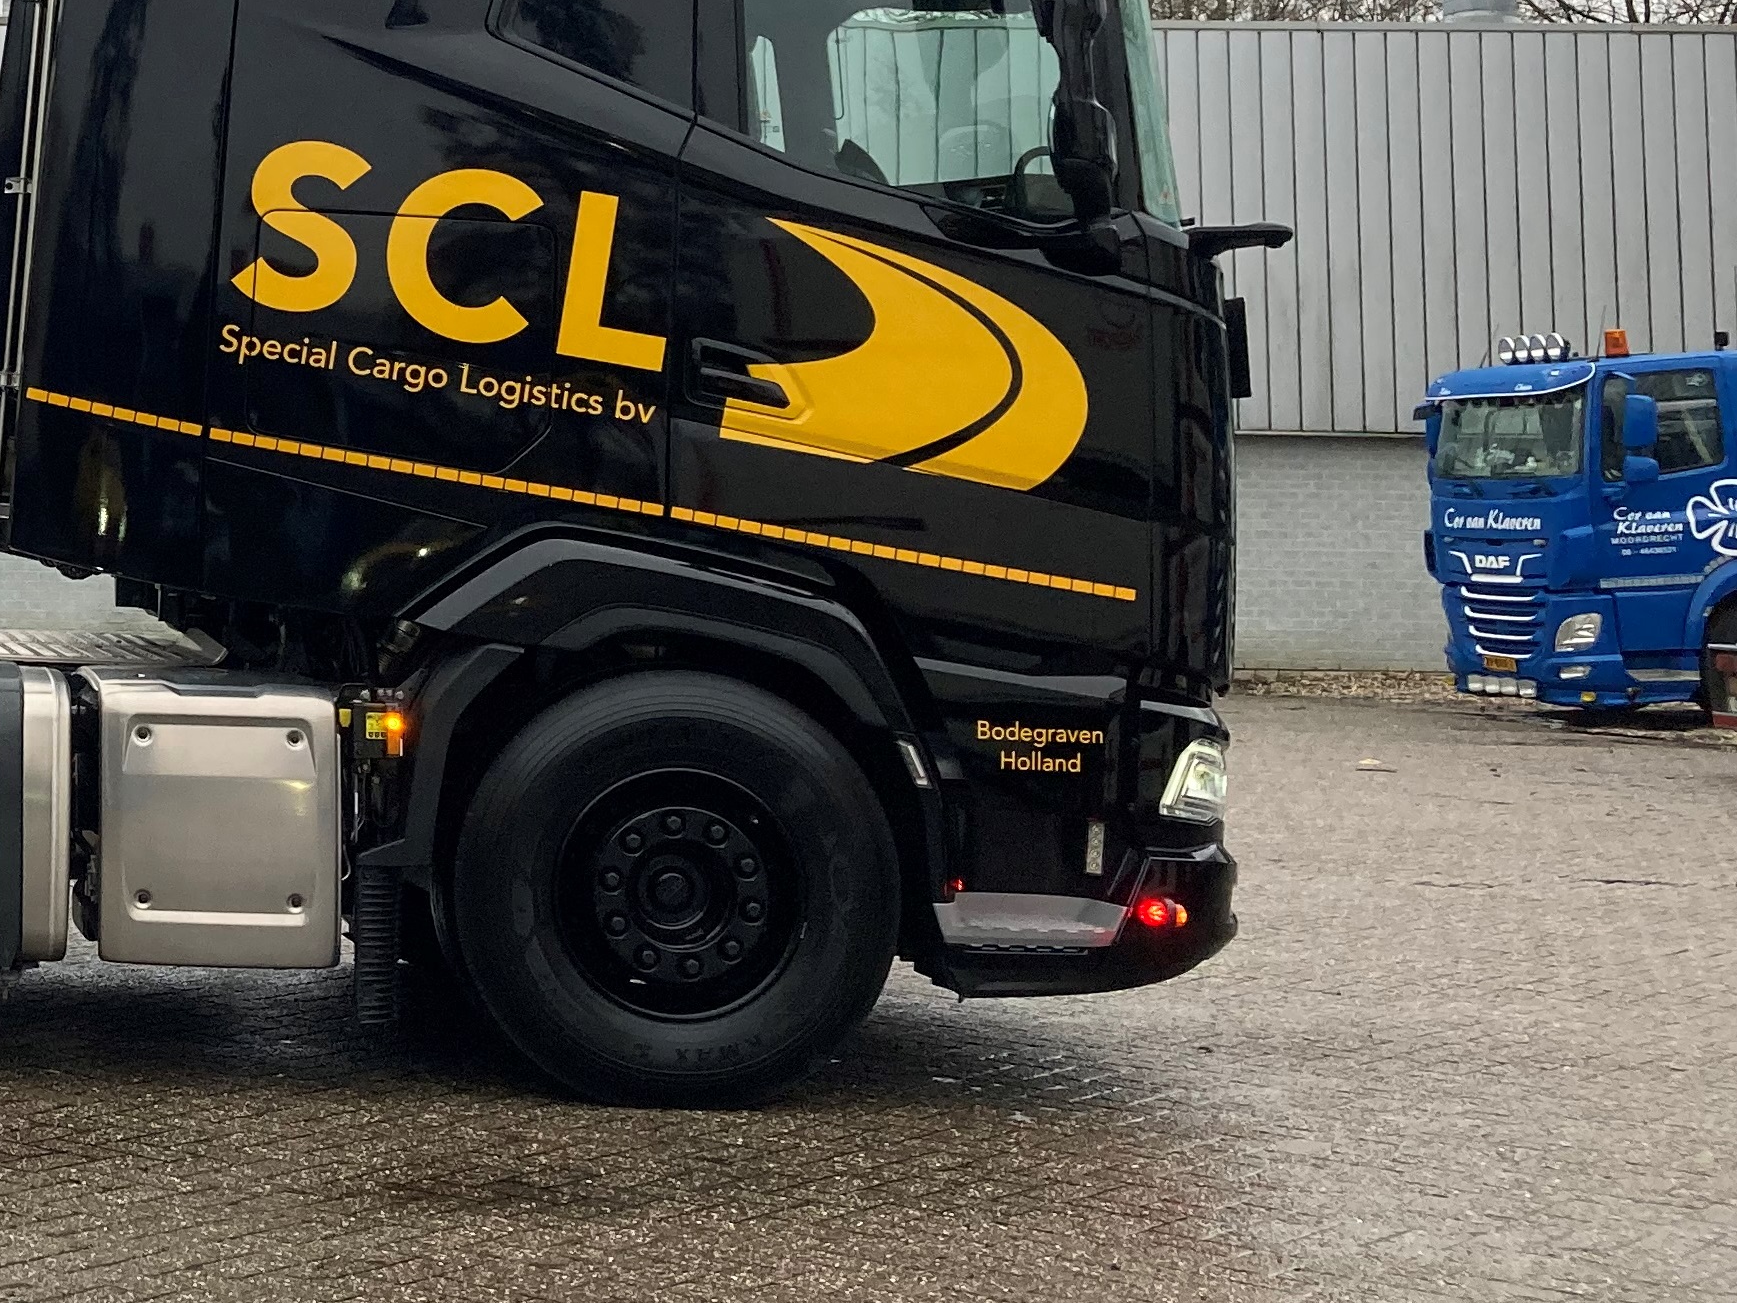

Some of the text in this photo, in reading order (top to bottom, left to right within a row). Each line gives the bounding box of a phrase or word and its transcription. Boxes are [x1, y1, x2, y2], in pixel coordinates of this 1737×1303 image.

[230, 140, 667, 373] SCL
[220, 323, 656, 424] Special Cargo Logistics bv
[1474, 554, 1511, 569] DAF
[977, 719, 1104, 748] Bodegraven
[1000, 751, 1082, 773] Holland
